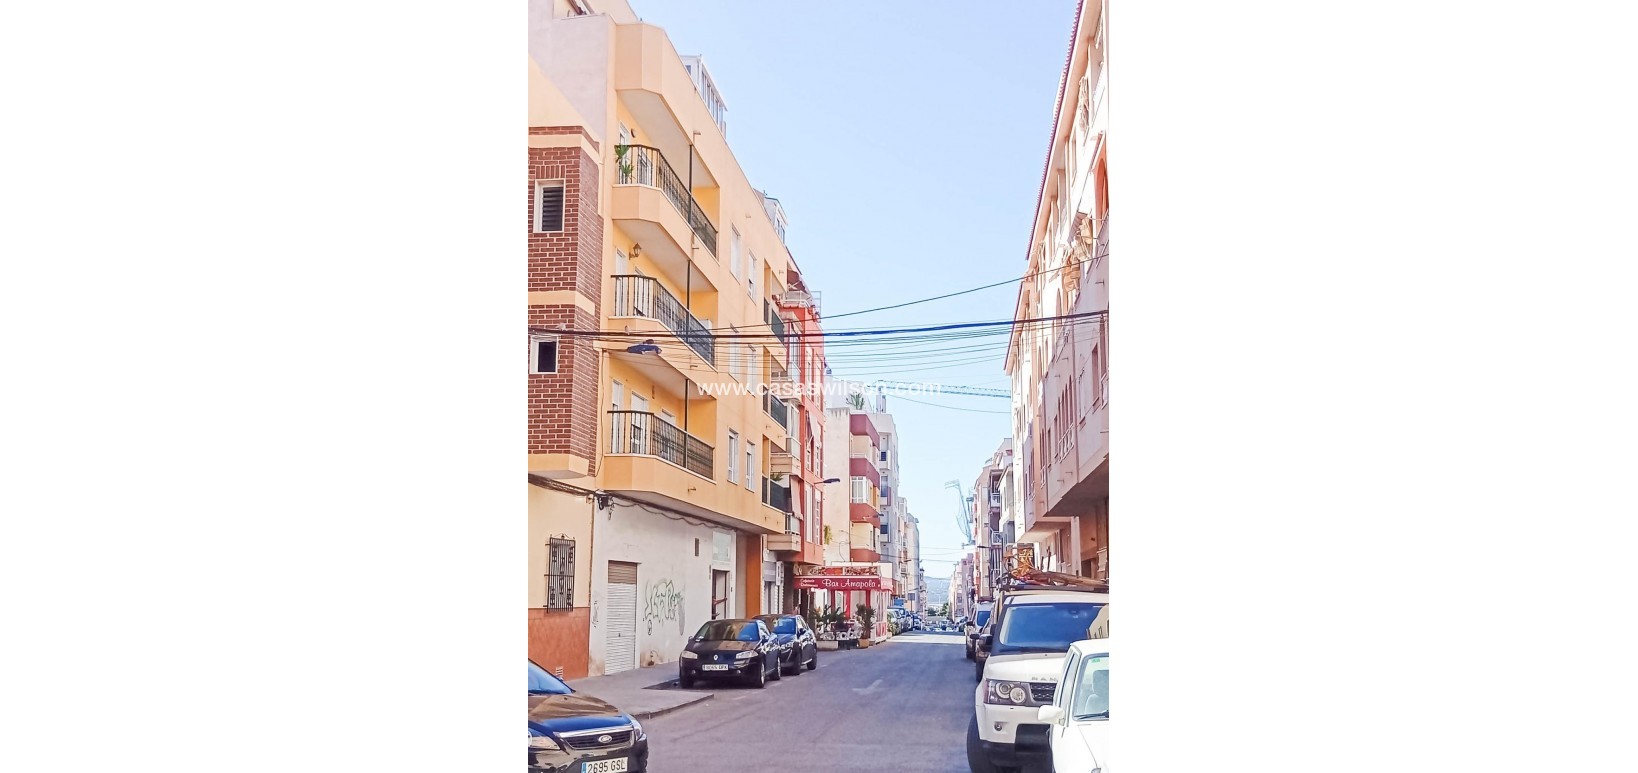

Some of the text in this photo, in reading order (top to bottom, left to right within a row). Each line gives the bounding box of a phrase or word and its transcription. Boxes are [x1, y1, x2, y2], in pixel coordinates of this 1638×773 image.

[822, 578, 839, 587] Bar
[841, 578, 876, 589] Amapola
[588, 760, 626, 773] 2695 GSL
